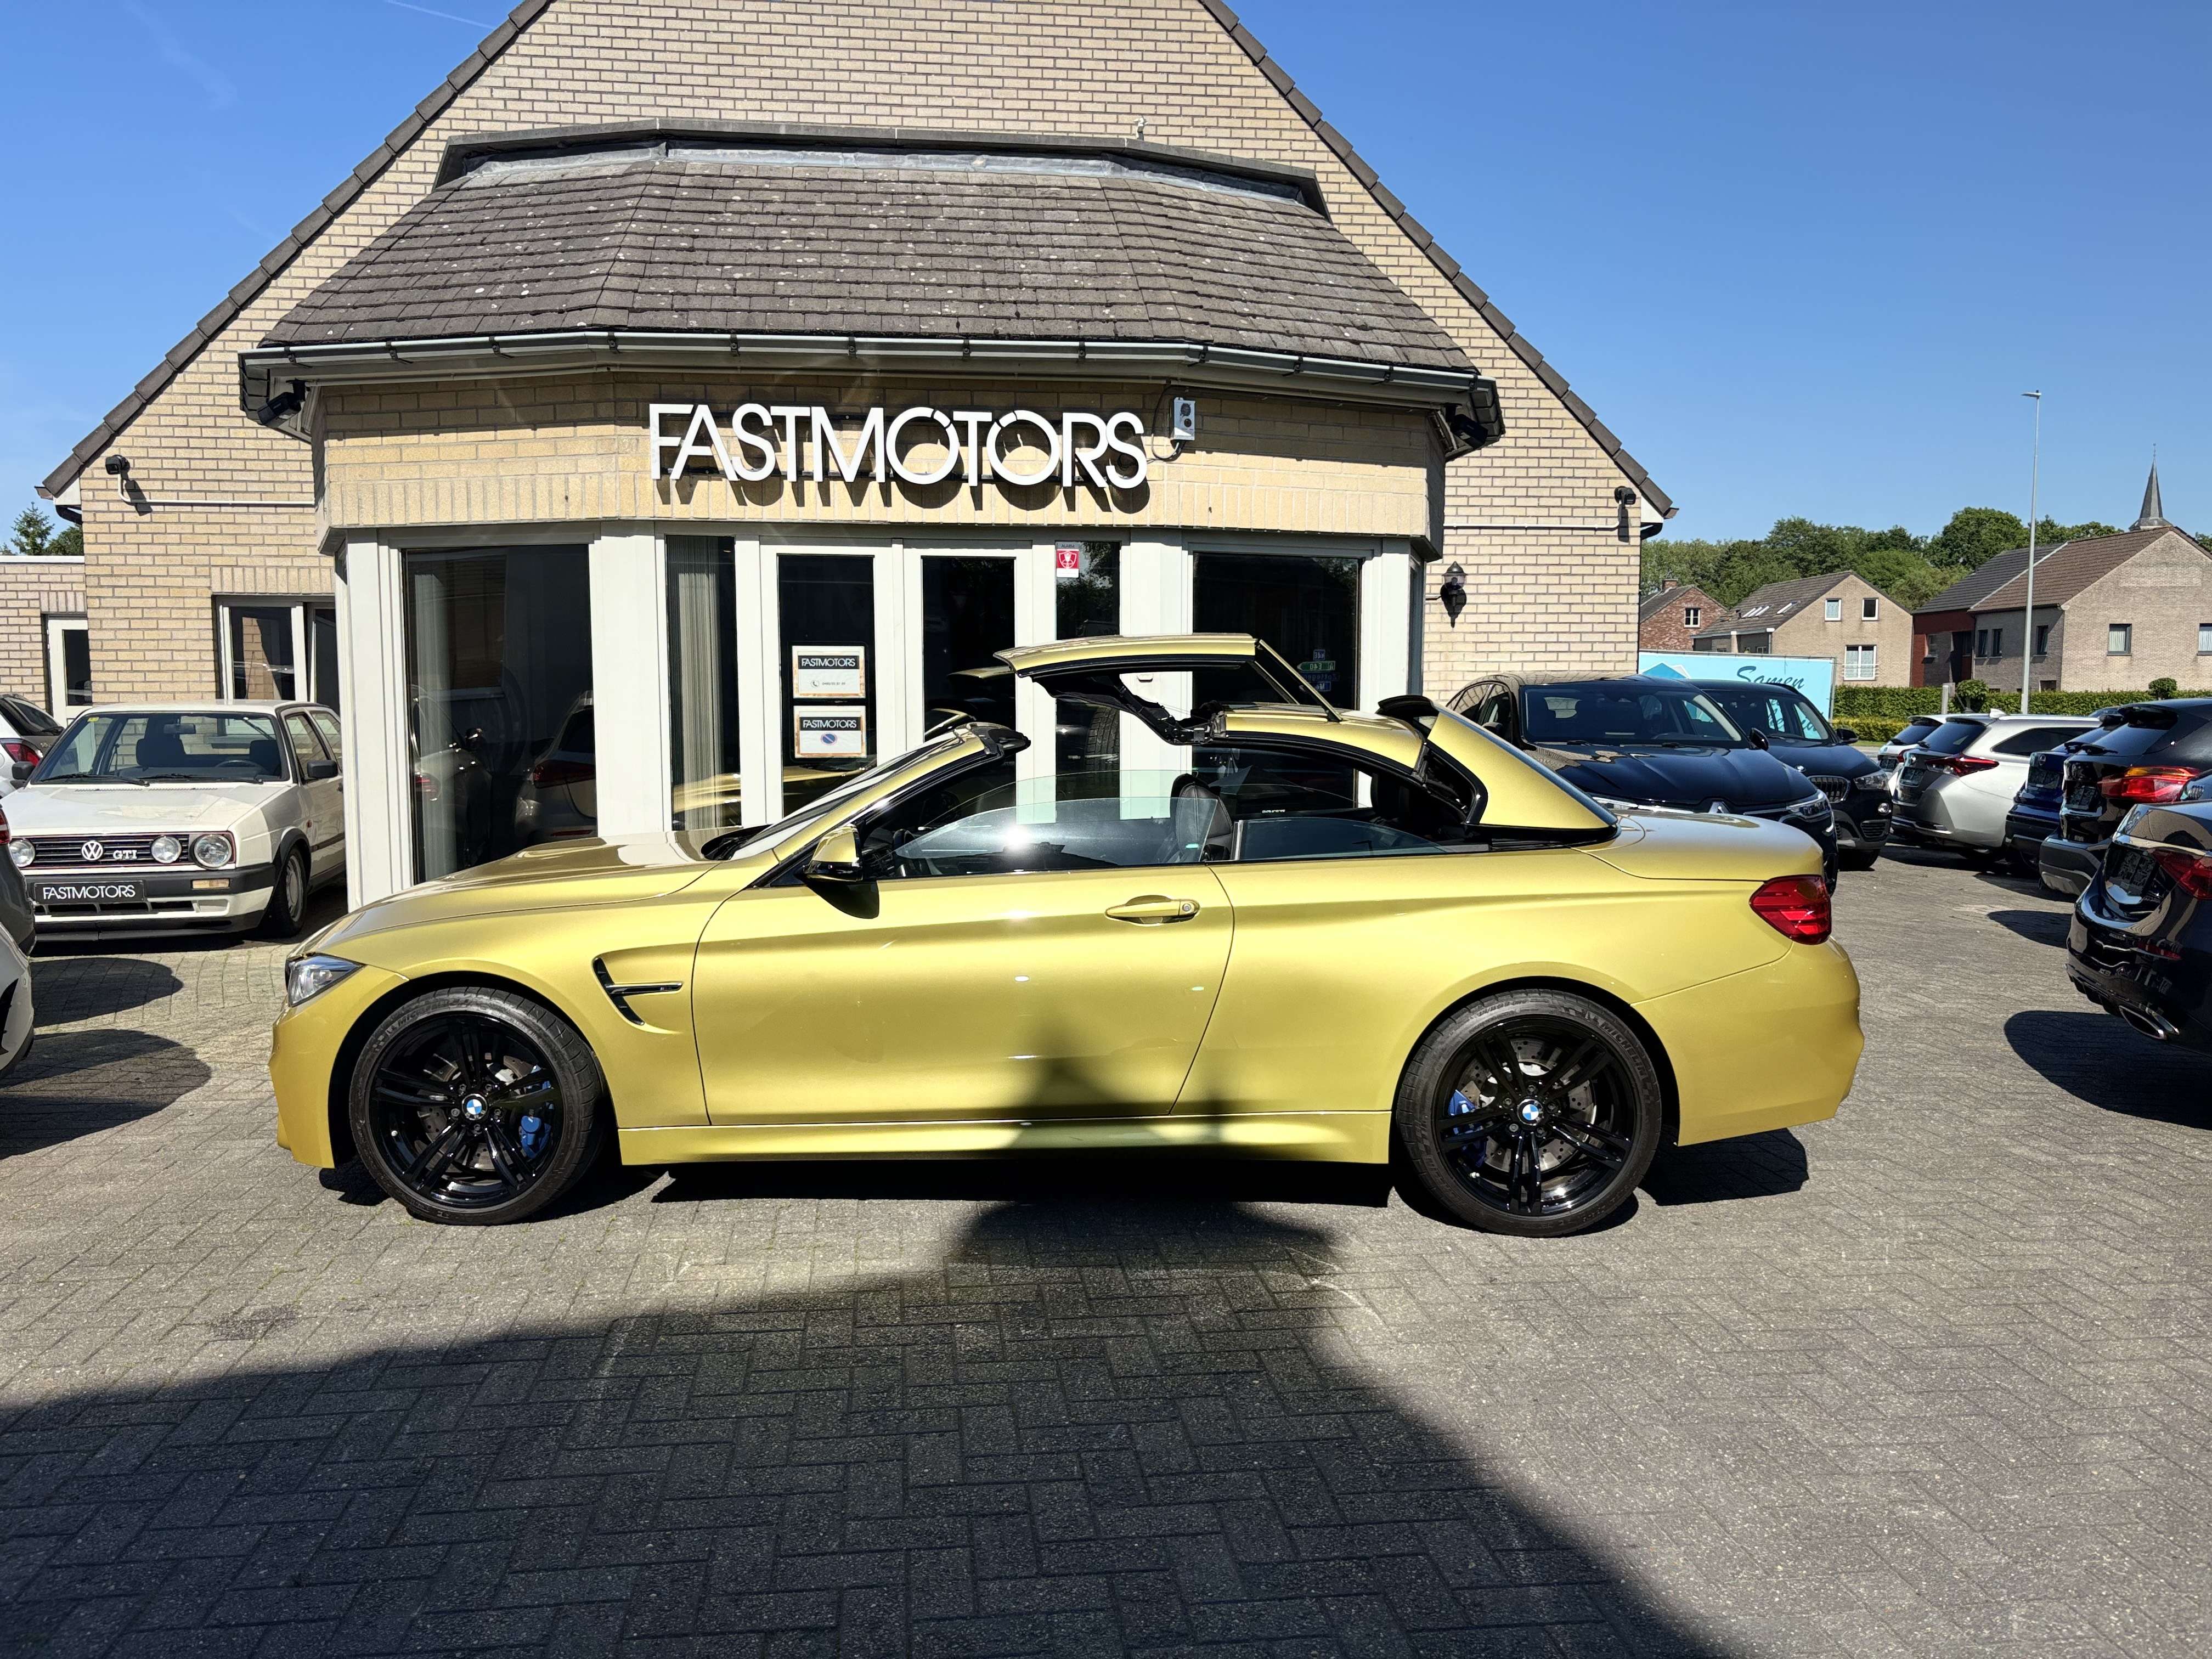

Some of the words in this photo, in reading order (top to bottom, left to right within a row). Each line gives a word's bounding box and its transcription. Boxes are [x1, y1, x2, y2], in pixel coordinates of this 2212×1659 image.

[649, 403, 1147, 489] FASTMOTORS
[802, 658, 856, 667] FASTMOTORS
[803, 719, 857, 728] FASTMOTORS
[113, 850, 138, 860] GTI
[43, 884, 136, 900] FASTMOTORS
[1600, 1021, 1649, 1079] MICHELIN
